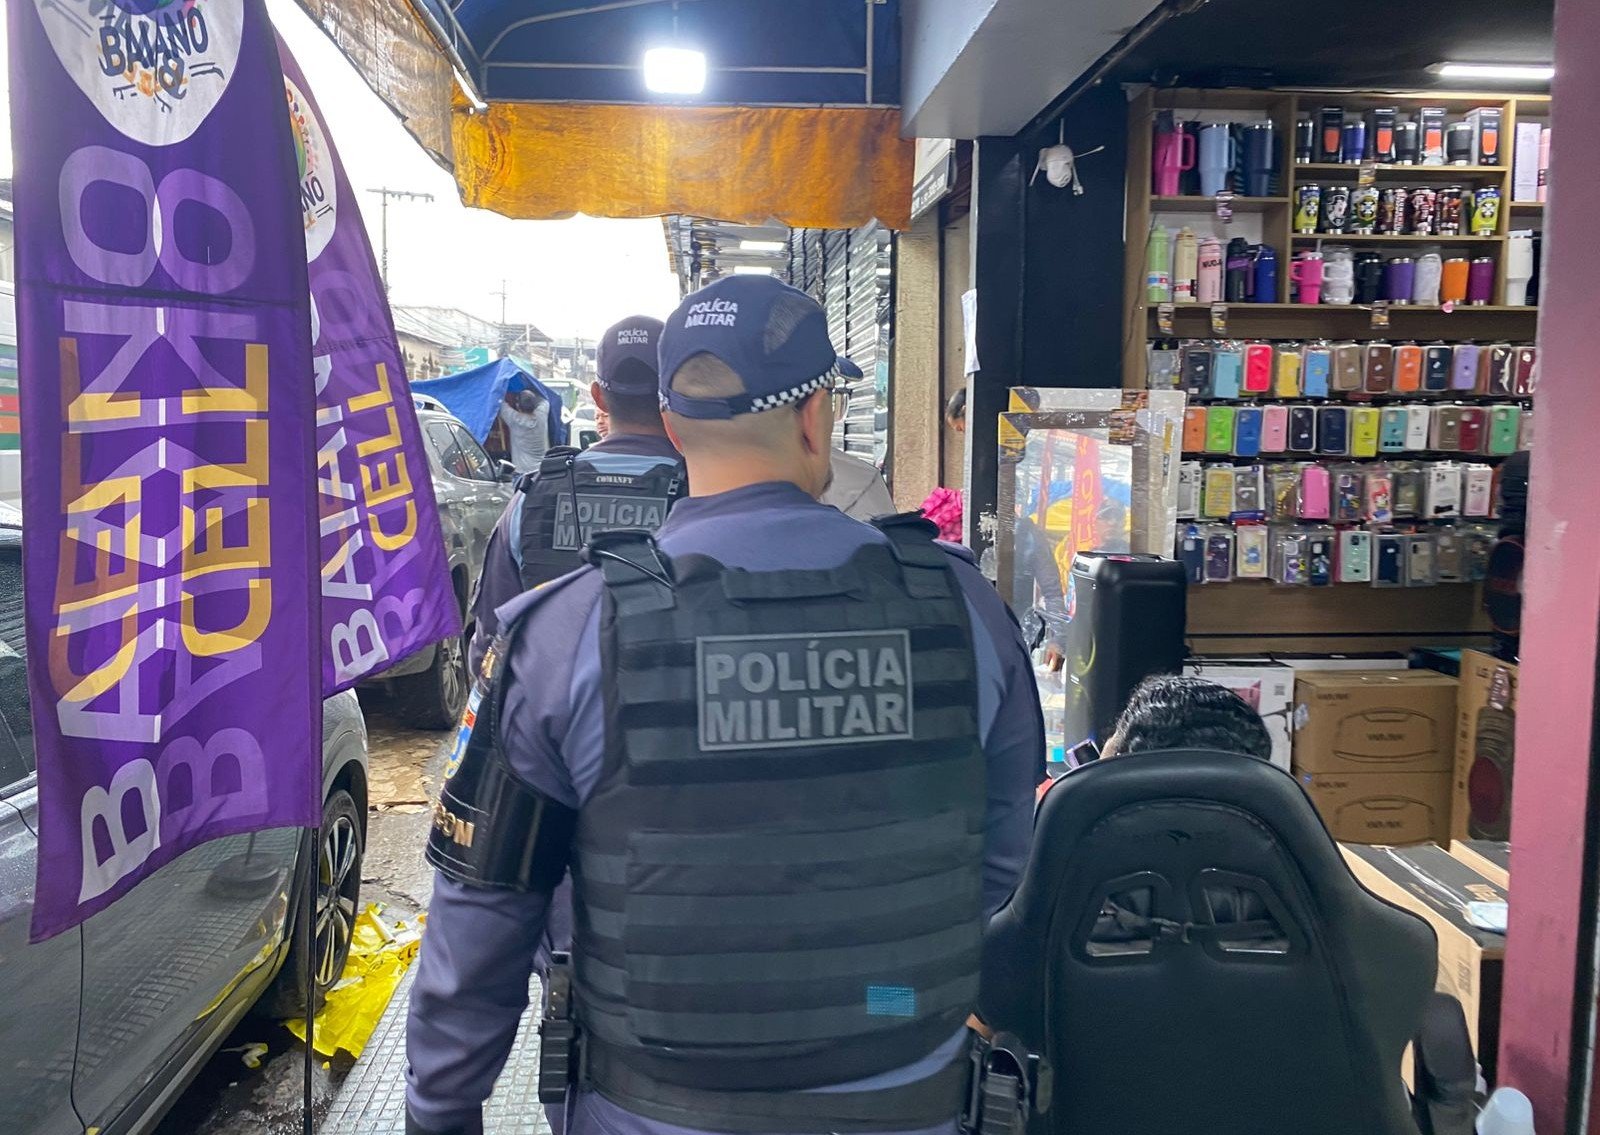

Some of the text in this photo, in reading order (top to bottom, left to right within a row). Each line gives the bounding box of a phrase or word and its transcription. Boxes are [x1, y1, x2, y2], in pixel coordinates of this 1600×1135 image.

[684, 313, 737, 329] MILITAR
[687, 297, 739, 315] POLÍCIA
[616, 336, 649, 345] MILITAR
[346, 361, 419, 552] CELL
[56, 144, 165, 906] BAIANO
[180, 343, 272, 658] CELL
[558, 498, 661, 527] POLÍCIA
[704, 639, 906, 695] POLÍCIA
[705, 692, 907, 743] MILITAR
